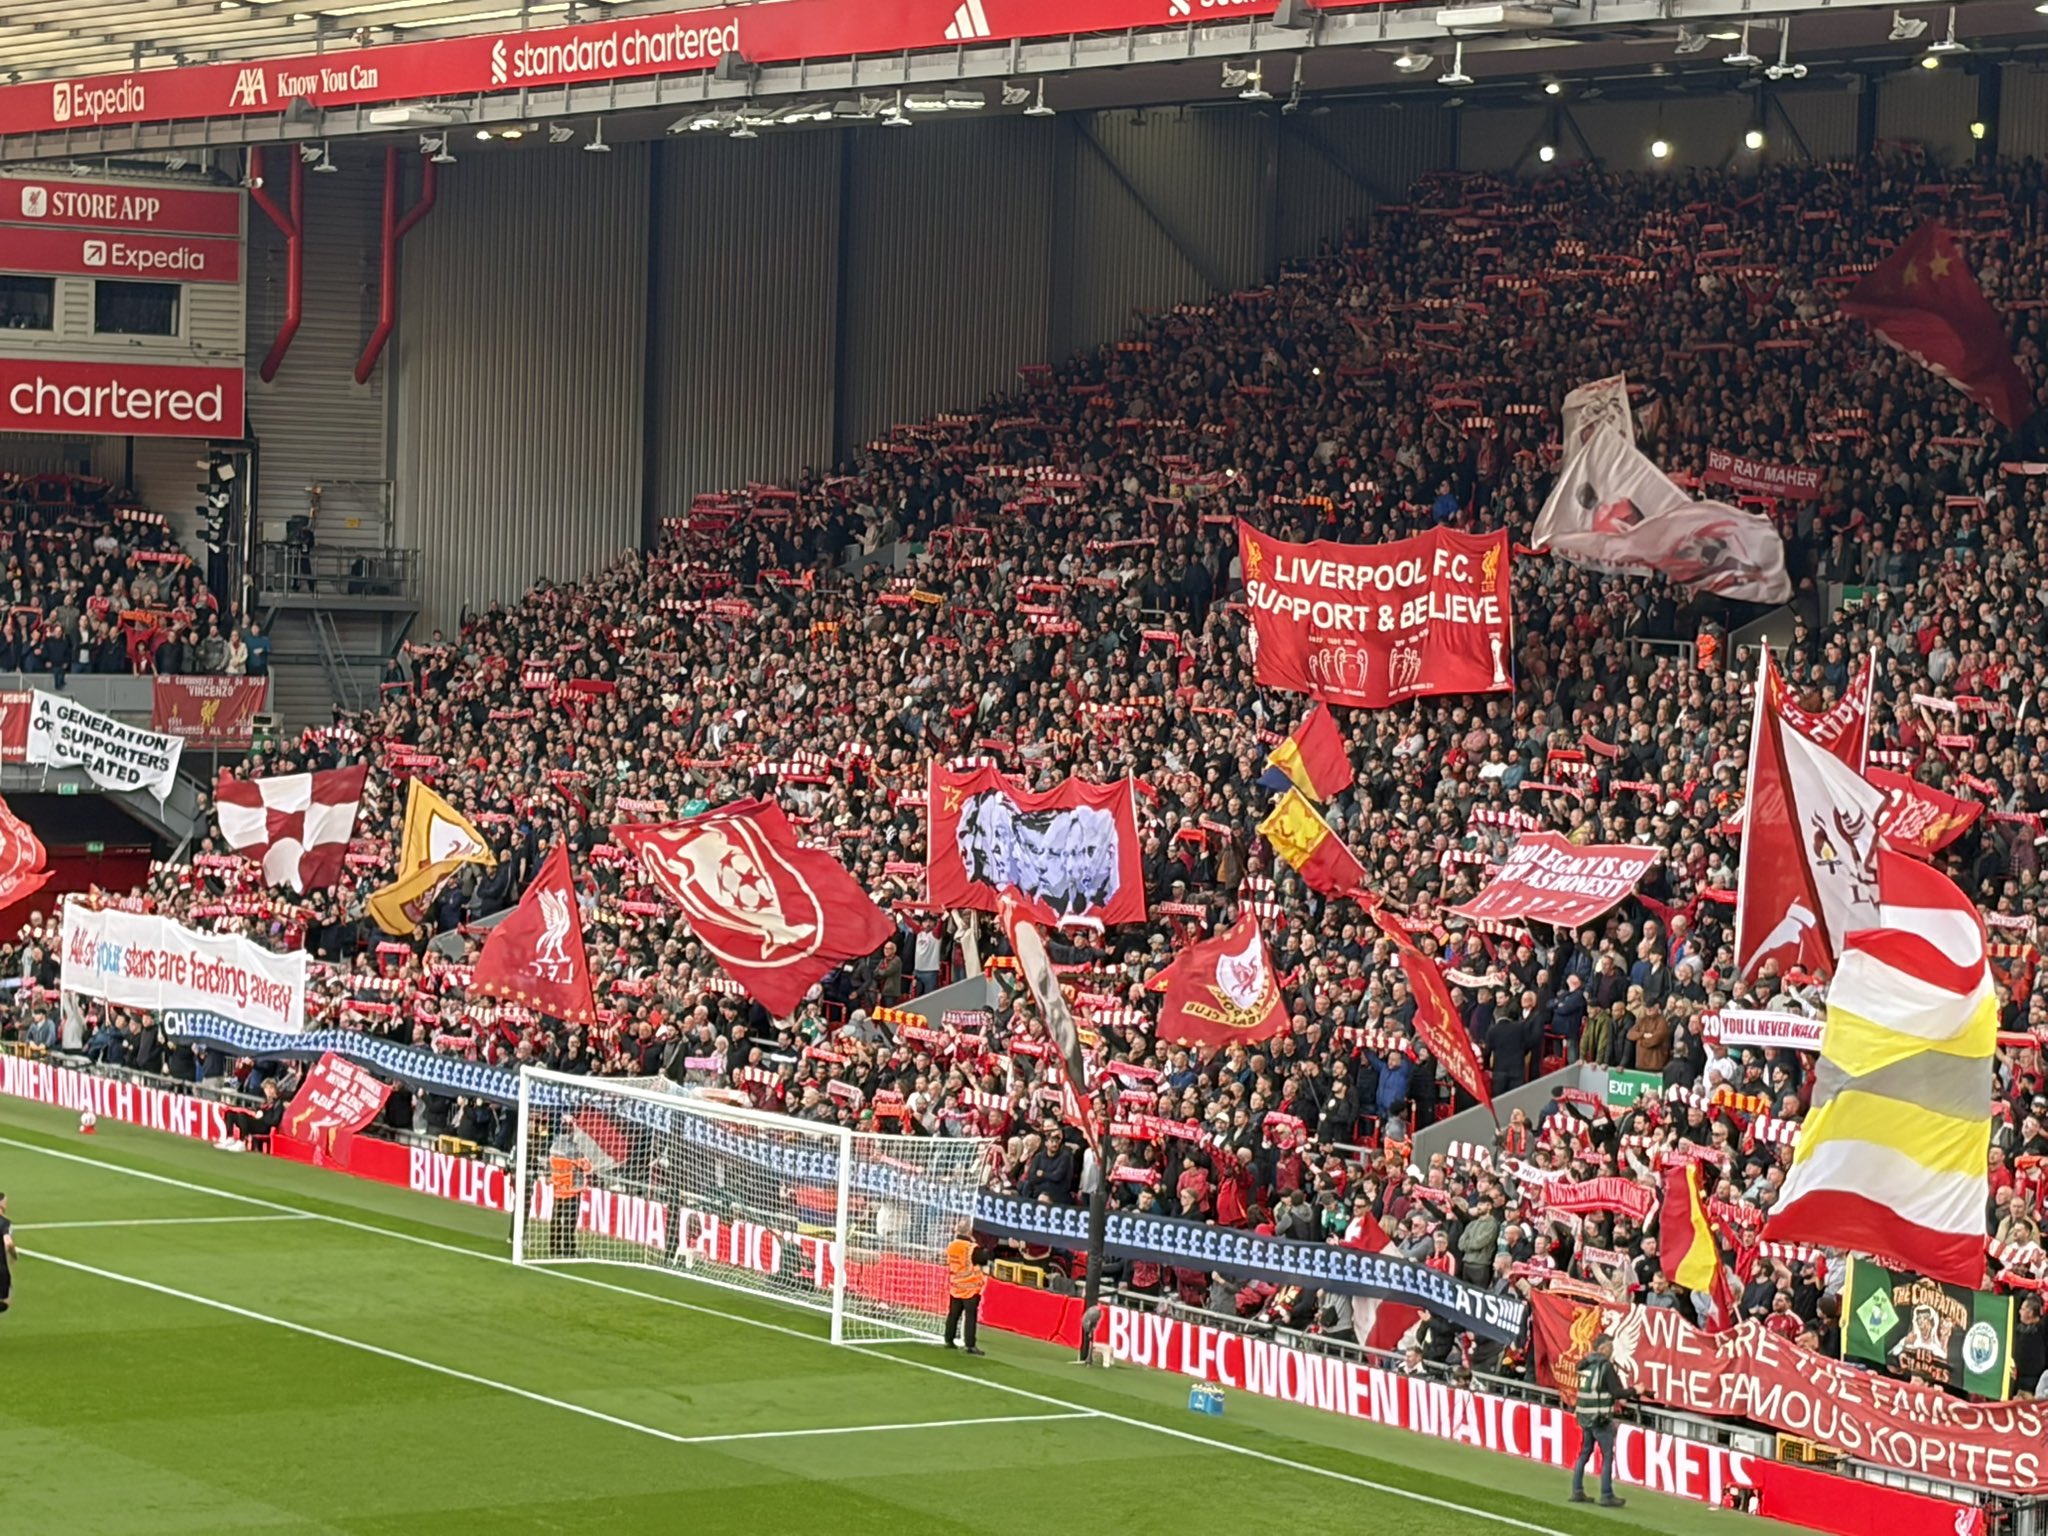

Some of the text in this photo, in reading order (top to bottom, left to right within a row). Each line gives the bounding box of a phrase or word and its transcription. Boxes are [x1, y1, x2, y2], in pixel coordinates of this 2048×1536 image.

[513, 17, 739, 78] standard chartered
[74, 78, 145, 125] Expedia
[229, 67, 268, 107] AXA
[277, 65, 378, 98] Know You Can
[52, 191, 160, 222] STORE APP
[111, 243, 205, 272] Expedia
[10, 376, 223, 422] chartered
[1708, 452, 1817, 488] RIP RAY MAHER
[1274, 548, 1474, 591] LIVERPOOL F.C.
[1247, 580, 1502, 632] SUPPORT & BELIEVE
[34, 717, 170, 772] OF SUPPORTERS
[40, 700, 168, 751] A GENERATION
[1521, 869, 1555, 890] AS
[1594, 856, 1615, 876] IS
[1613, 858, 1645, 879] SO
[69, 926, 85, 964] All
[96, 940, 123, 978] your
[124, 942, 156, 980] stars
[158, 949, 187, 985] are
[190, 951, 247, 1009] fading
[250, 973, 293, 1022] away
[1758, 1019, 1791, 1037] NEVER
[1791, 1022, 1824, 1041] WALK
[2, 1054, 228, 1143] MEN MATCH TICKETS
[1608, 1079, 1635, 1097] EXIT
[410, 1146, 454, 1198] BUY
[458, 1158, 499, 1209] LFC
[503, 1174, 610, 1234] OEN
[616, 1192, 718, 1261] MACH
[1599, 1177, 1622, 1202] WALK
[1893, 1284, 1911, 1307] THE
[1640, 1304, 2043, 1439] WE ARE THE FAMOUS
[1899, 1353, 1949, 1383] CHARGES
[1916, 1349, 1932, 1363] 115
[1109, 1305, 1756, 1507] BUY LFC WOMEN MATCH CKETS
[1644, 1360, 2040, 1489] THE FAMOUS KOPITES
